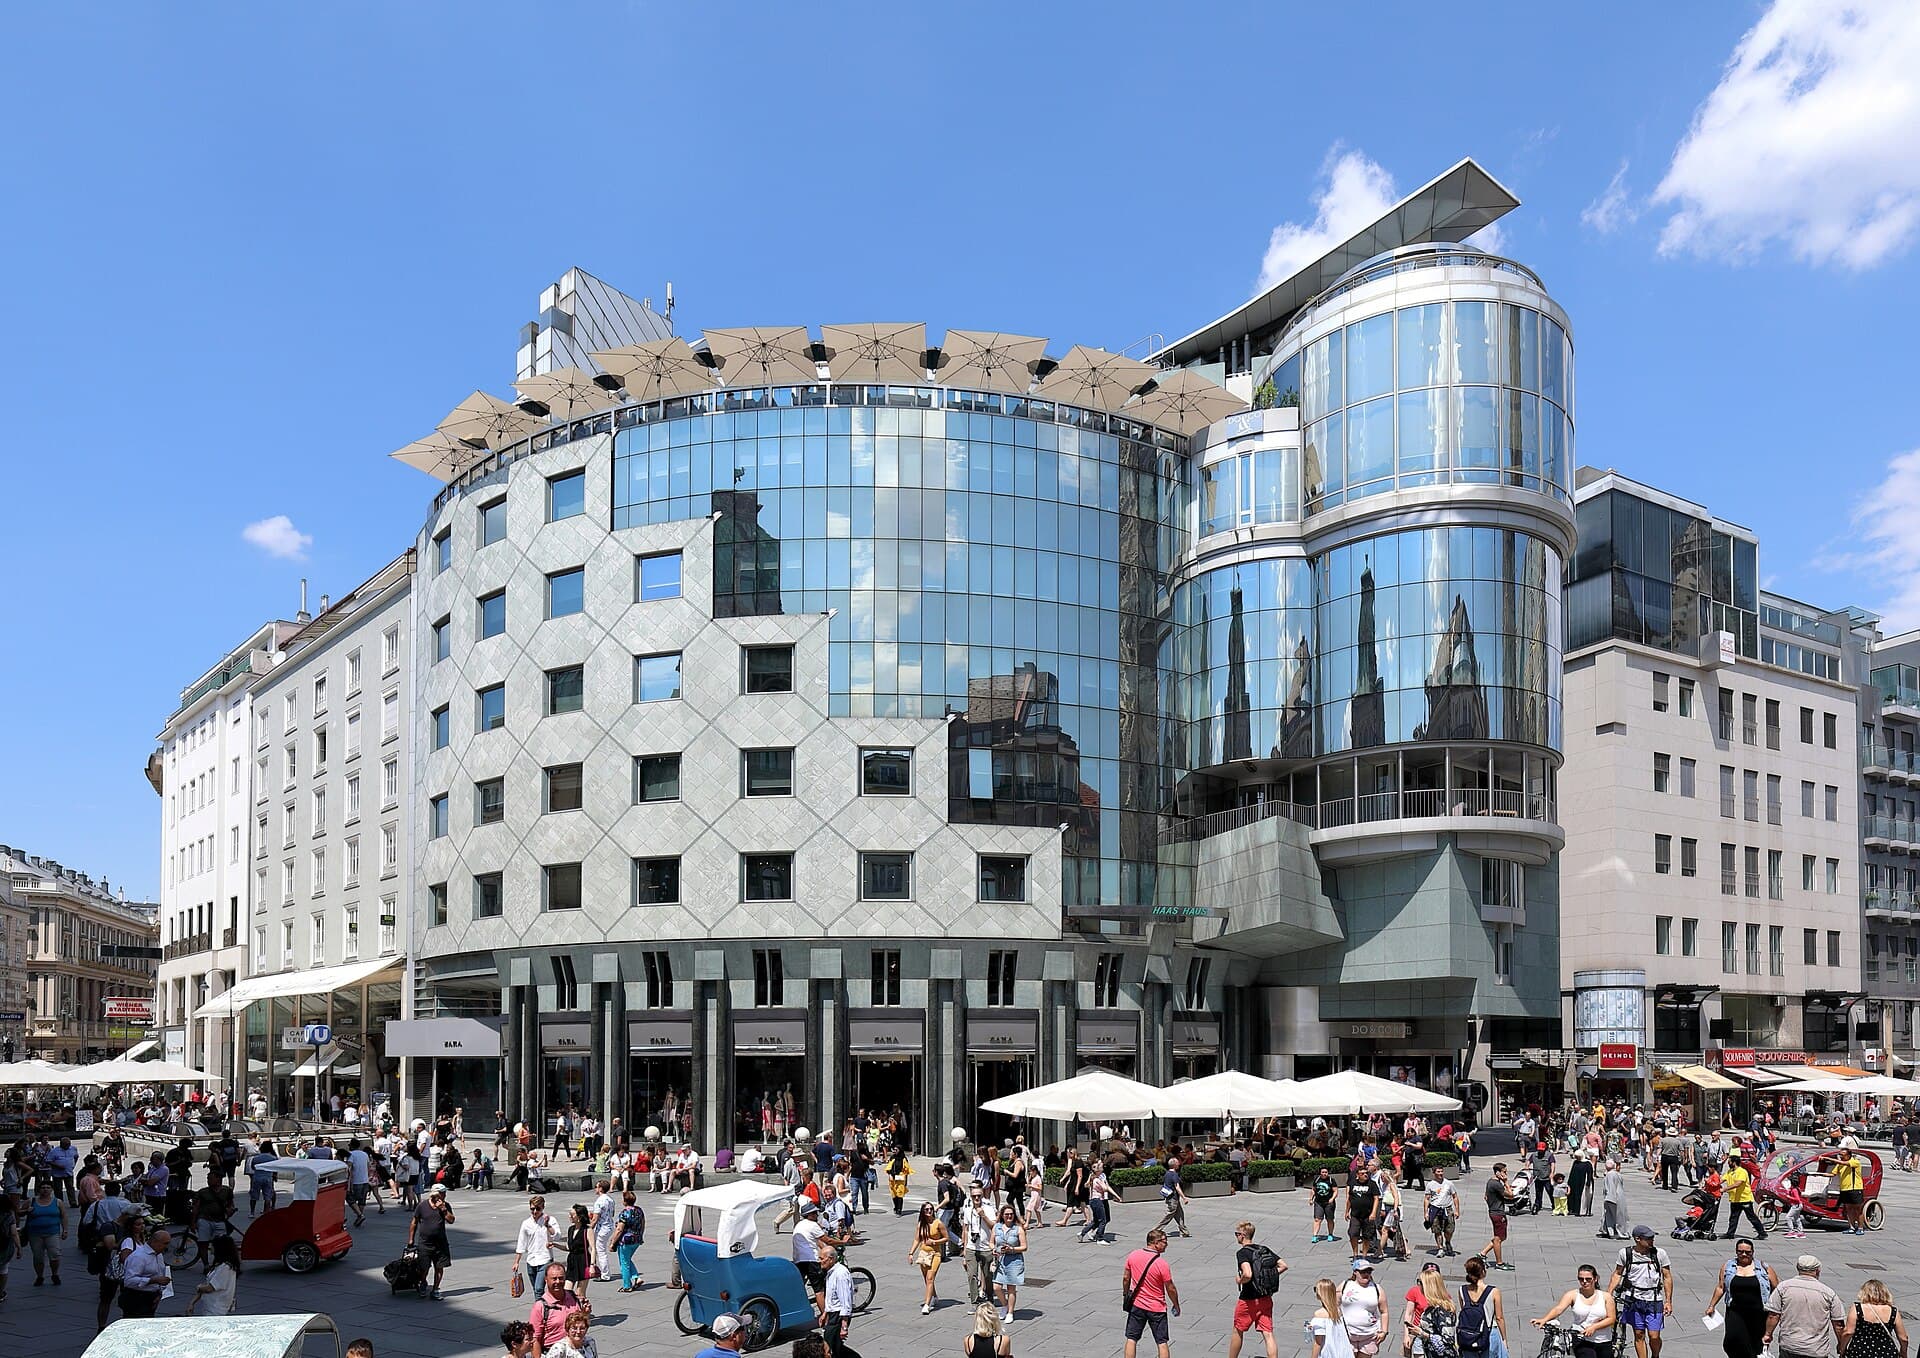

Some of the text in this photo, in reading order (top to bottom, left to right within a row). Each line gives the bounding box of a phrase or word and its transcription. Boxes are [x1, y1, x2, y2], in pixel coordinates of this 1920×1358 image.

[1152, 906, 1207, 916] HAAS HAUS
[1352, 1025, 1368, 1034] DO
[314, 1028, 328, 1042] U
[1724, 1053, 1754, 1062] SOUVENIRS
[1758, 1052, 1807, 1061] SOUVENIRS
